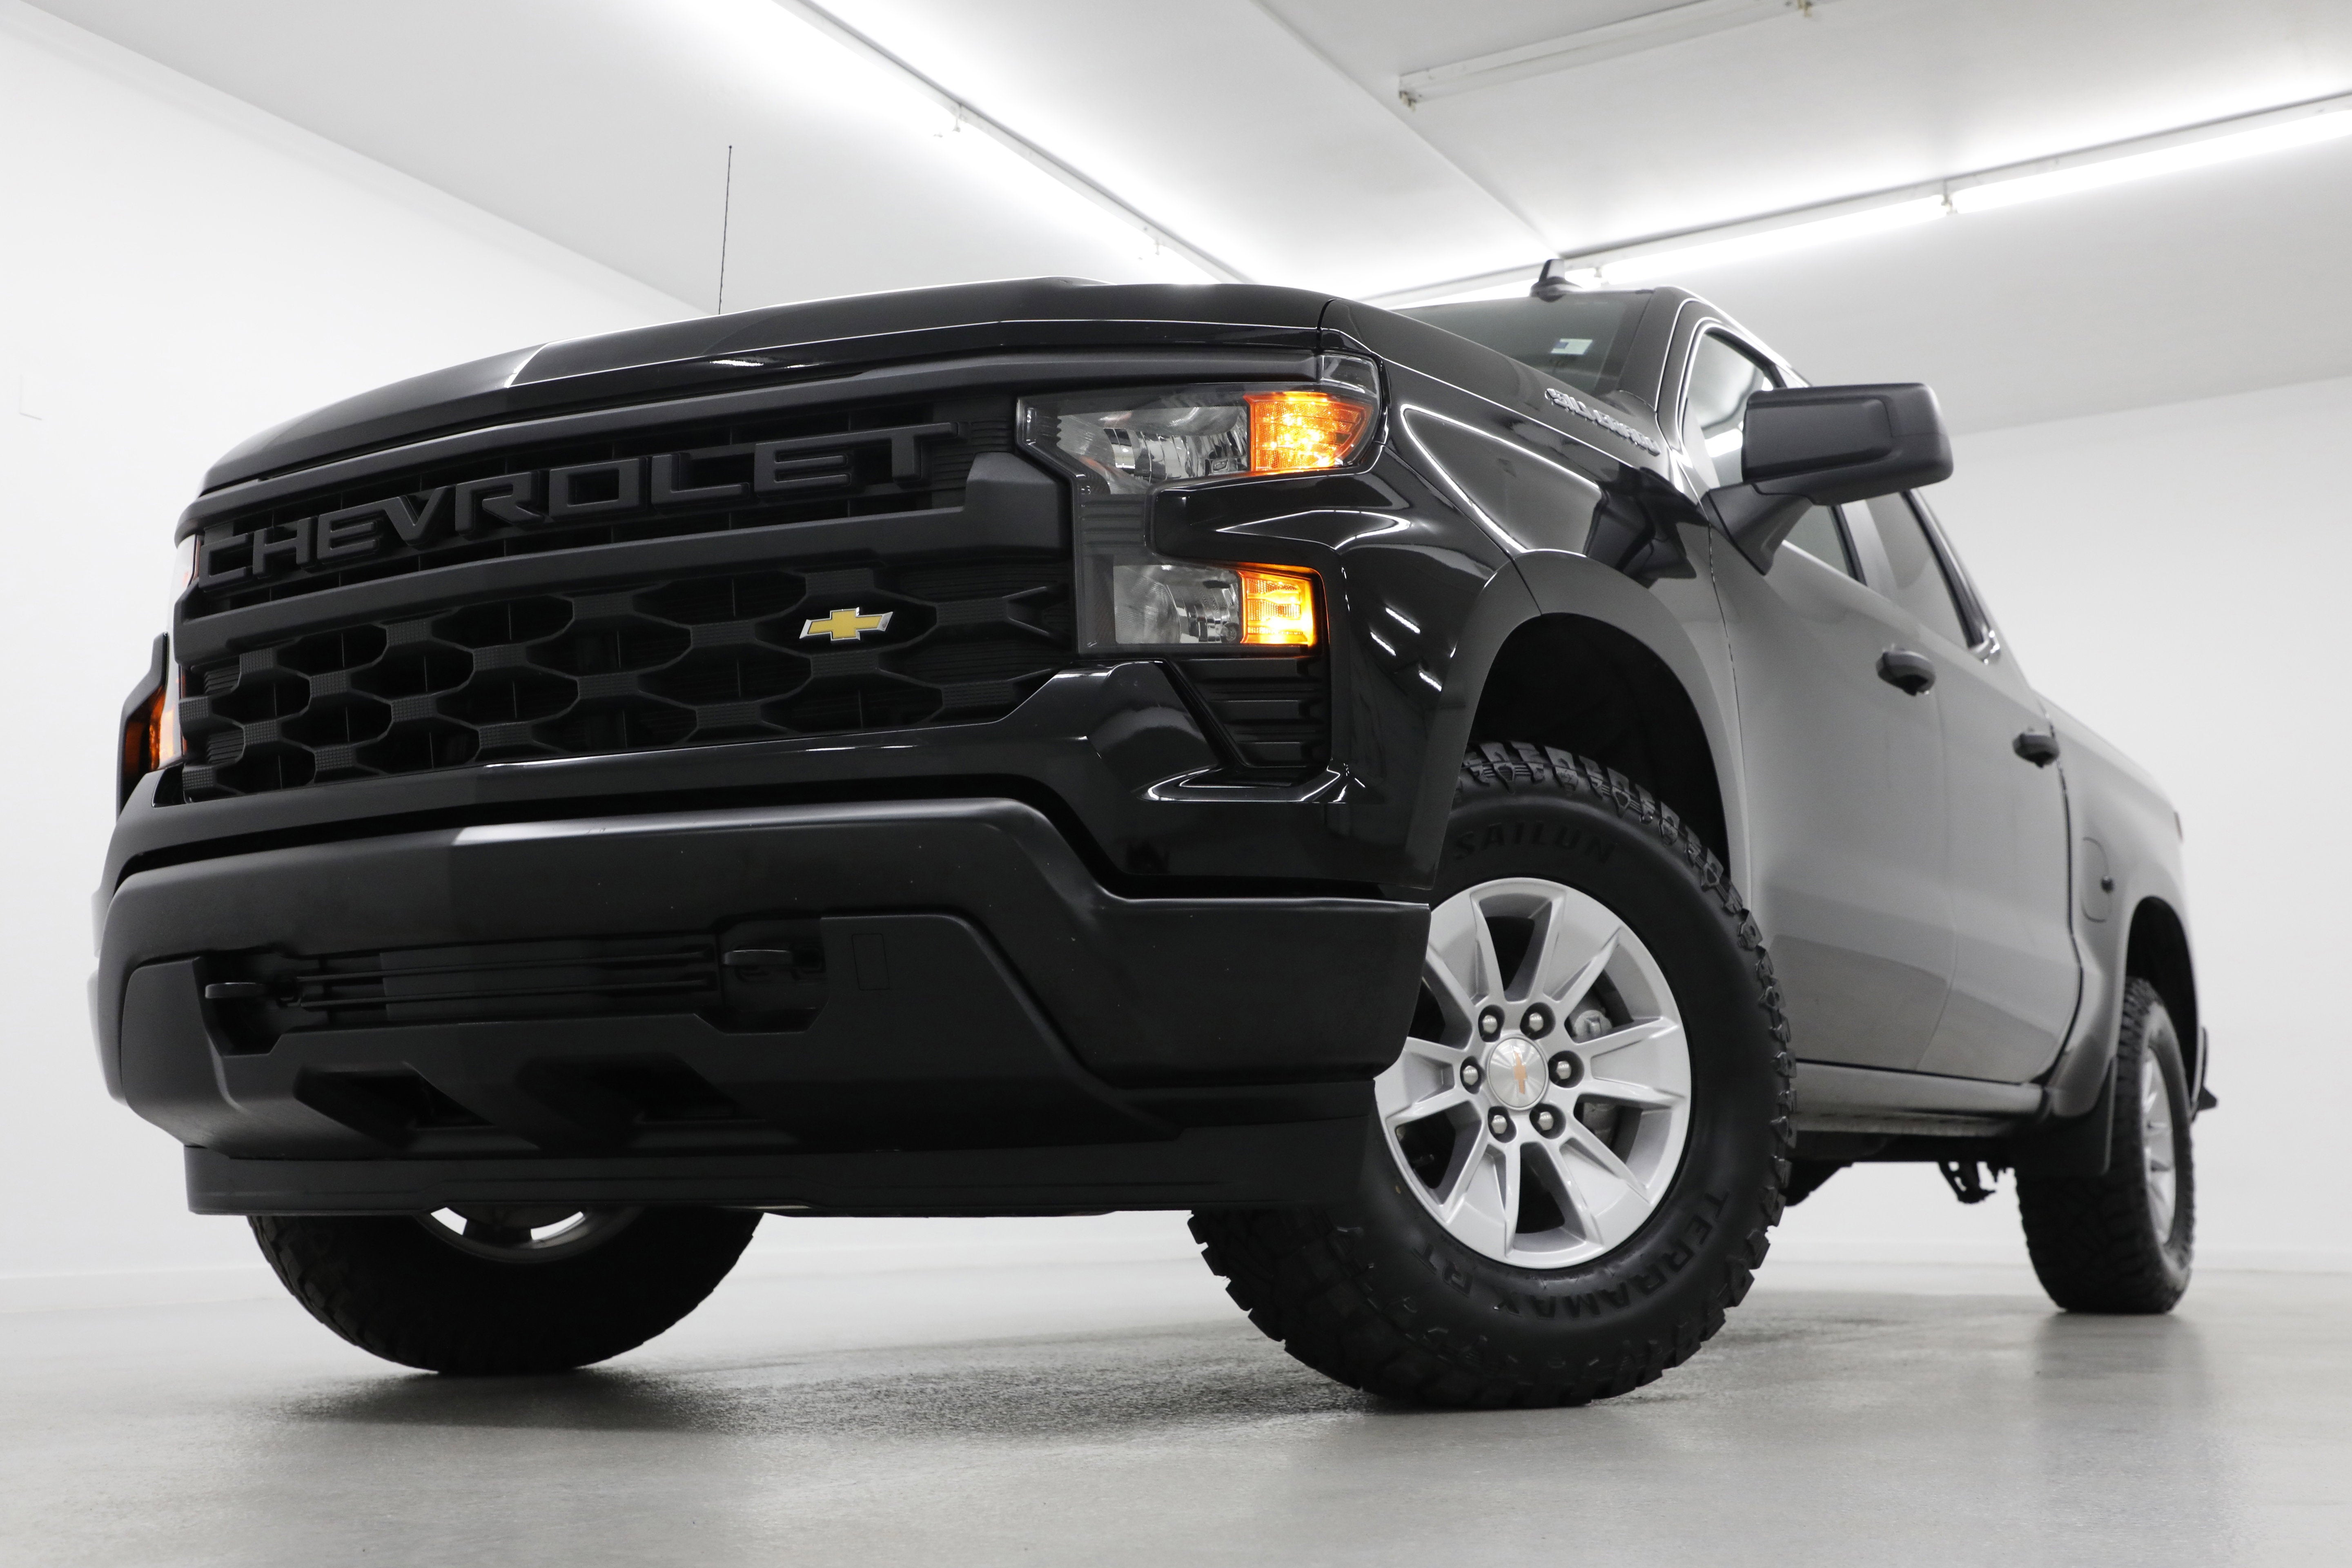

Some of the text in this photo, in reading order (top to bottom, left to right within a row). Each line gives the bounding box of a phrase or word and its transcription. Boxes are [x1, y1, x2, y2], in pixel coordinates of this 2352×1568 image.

[199, 422, 962, 589] CHEVROLET
[1454, 820, 1617, 864] SAILUN
[1494, 1192, 1731, 1319] TERRAMAX
